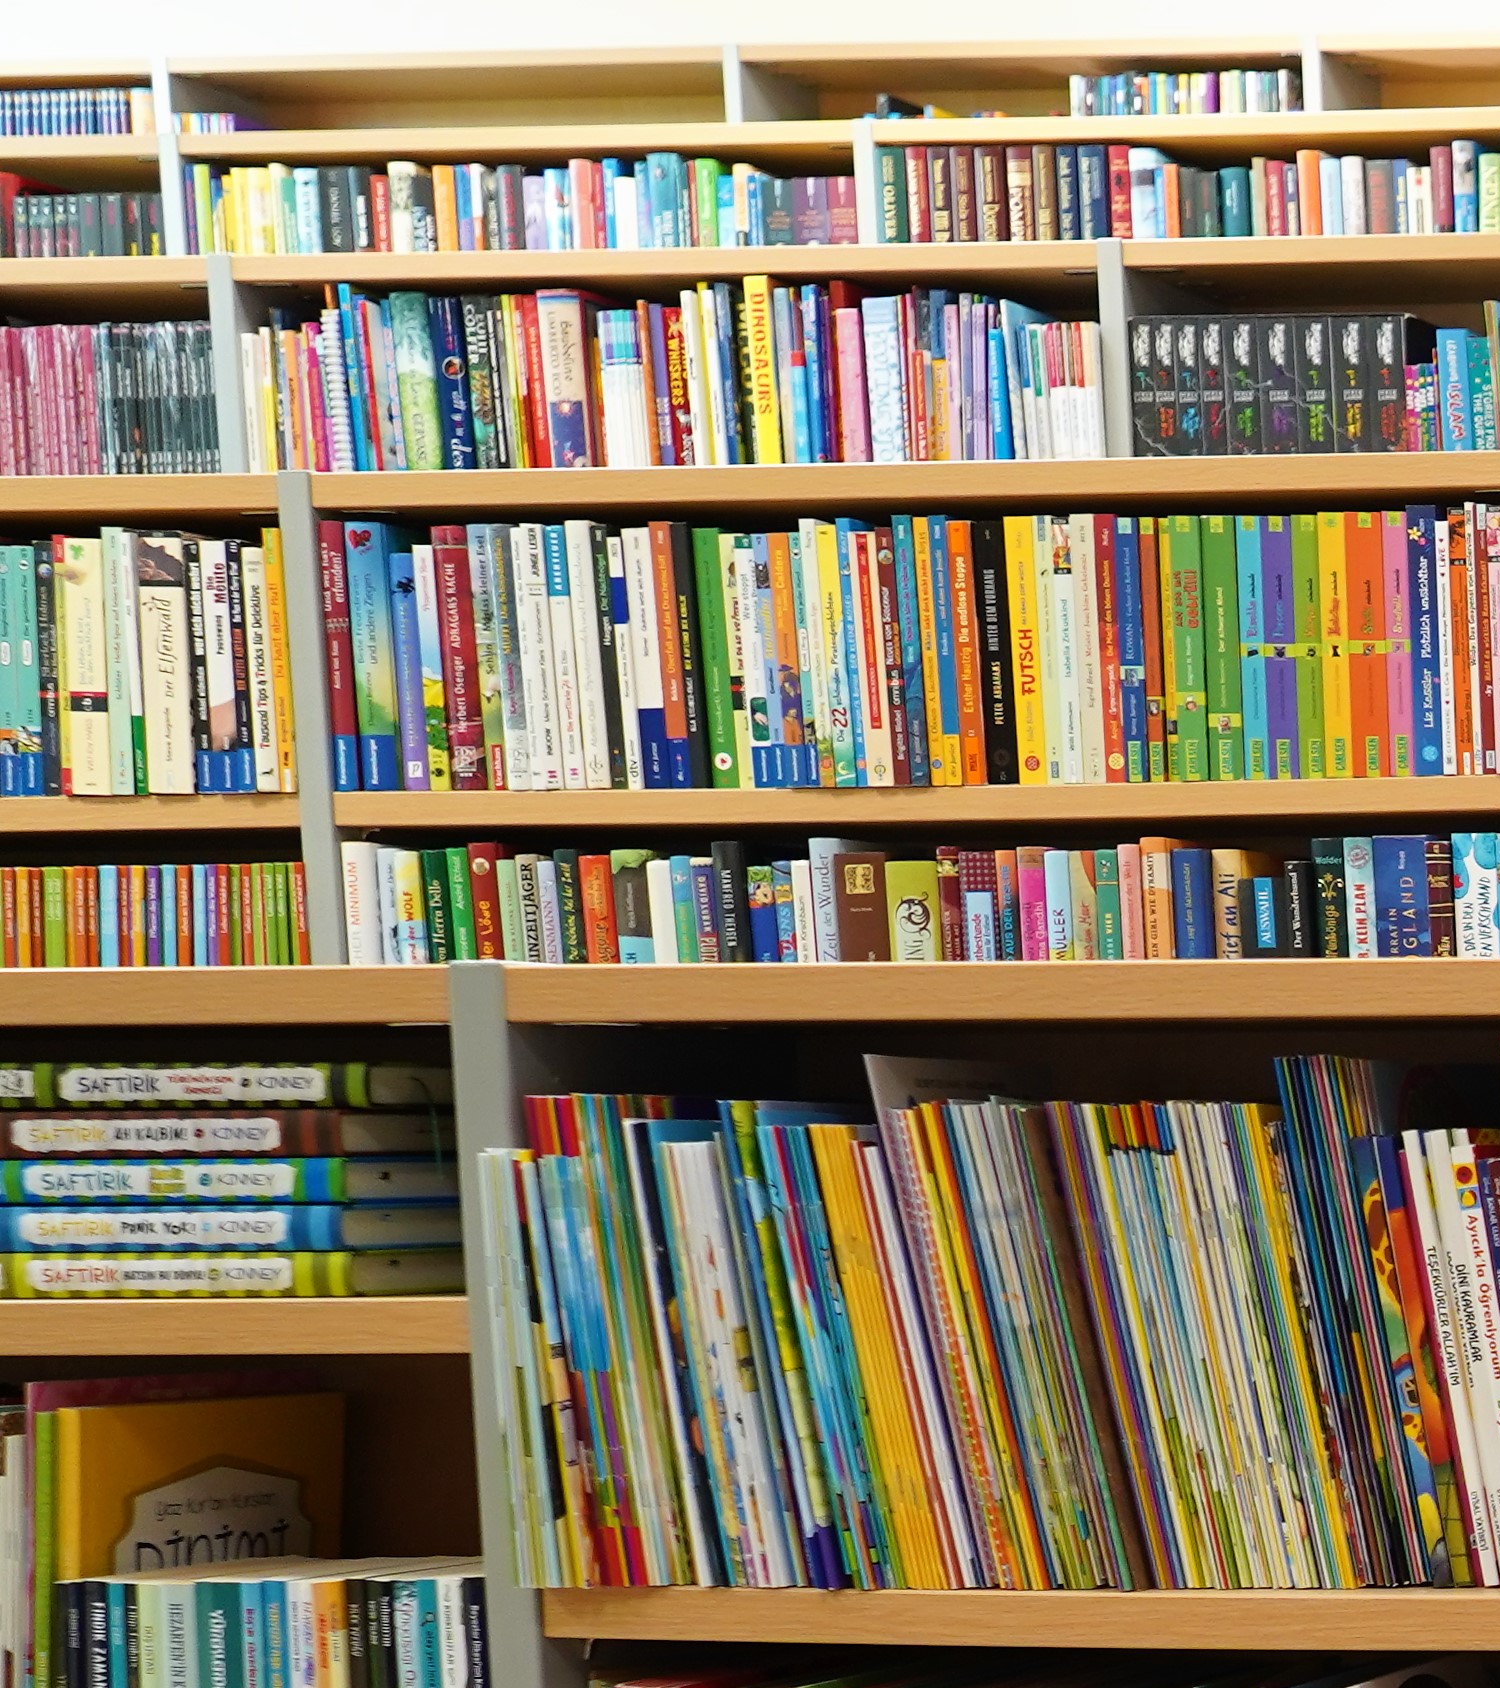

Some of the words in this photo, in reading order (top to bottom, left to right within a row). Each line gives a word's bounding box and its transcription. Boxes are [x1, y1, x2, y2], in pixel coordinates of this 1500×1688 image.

[753, 291, 770, 412] DINOSAURS
[1447, 339, 1461, 383] LEARNING
[1448, 384, 1465, 432] ISLAM
[330, 550, 345, 602] erfunden?
[443, 563, 457, 594] RACHE
[953, 556, 968, 588] Steppe
[1417, 555, 1431, 610] unsichtbar
[447, 596, 462, 648] ADRAGARS
[956, 590, 969, 625] endlose
[957, 628, 969, 642] Die
[1419, 614, 1433, 658] Plötzlich
[451, 656, 466, 693] Osenger
[961, 647, 974, 680] Hautzig
[991, 661, 1004, 699] ABRAHAMS
[1016, 629, 1036, 696] FUTSCH
[889, 670, 902, 705] omnibus
[962, 682, 975, 712] Esther
[1421, 667, 1435, 707] Kessler
[452, 696, 469, 732] Herbert
[995, 703, 1006, 724] PETER
[1422, 710, 1434, 727] Liz
[347, 862, 361, 925] MINIMUM
[1288, 872, 1301, 930] Wunderhund
[1354, 883, 1366, 913] PLAN
[1478, 876, 1493, 940] VERSCHWAND
[478, 901, 493, 935] Löwe
[1258, 887, 1271, 944] AUSWAHL
[1355, 916, 1367, 945] KEIN
[1292, 931, 1303, 949] Der
[77, 1075, 160, 1094] SAFTİRİK
[42, 1172, 133, 1190] SAFTİRİK
[1466, 1215, 1489, 1278] Ayıcık'la
[1454, 1264, 1470, 1287] DİNİ
[1425, 1246, 1451, 1327] TEŞEKKÜRLER
[1441, 1331, 1460, 1387] ALLAH'IM
[1460, 1290, 1483, 1364] KAVRAMLAR
[91, 1602, 109, 1641] FINDIK
[168, 1603, 188, 1676] HEZARFEN'İN
